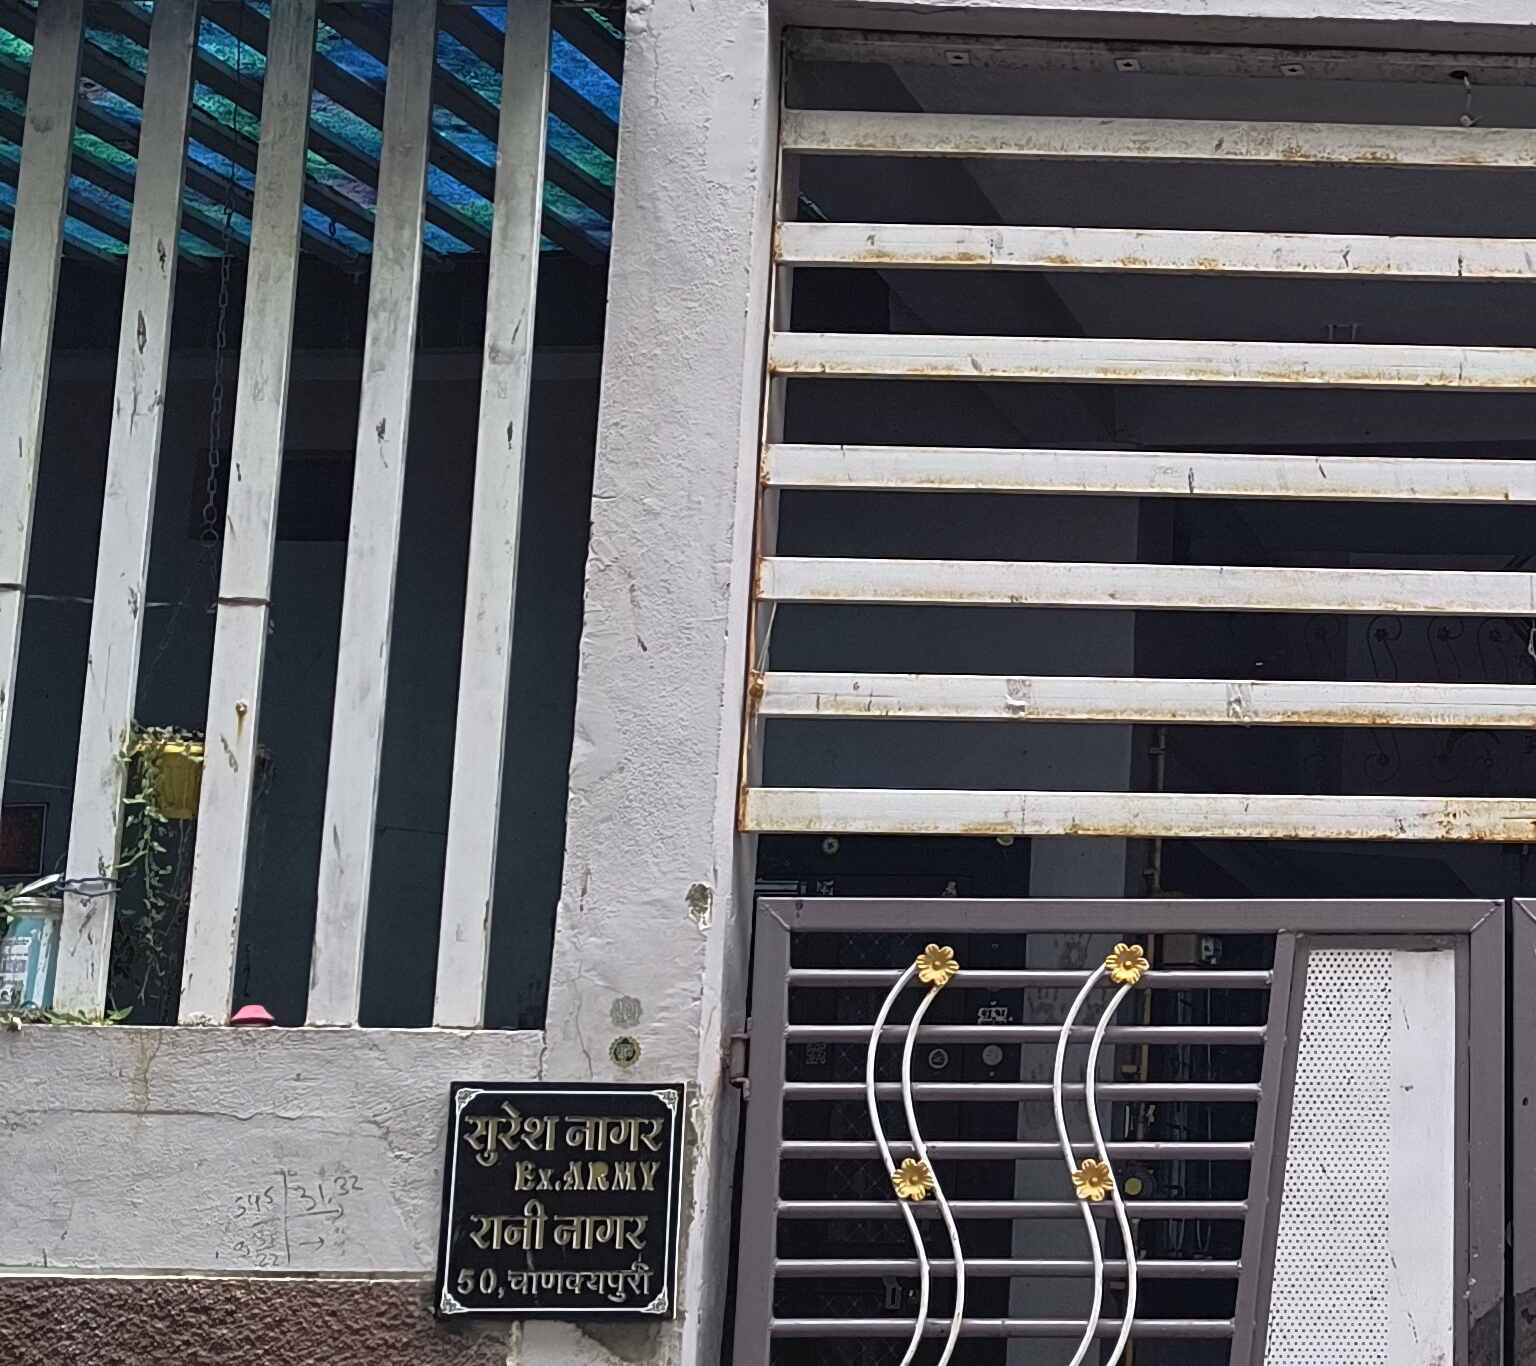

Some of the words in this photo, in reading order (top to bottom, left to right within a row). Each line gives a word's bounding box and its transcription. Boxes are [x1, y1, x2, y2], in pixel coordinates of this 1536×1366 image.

[463, 1101, 559, 1167] सुरेश
[564, 1116, 665, 1152] नागर
[469, 1198, 548, 1250] रानी
[553, 1215, 649, 1250] नागर
